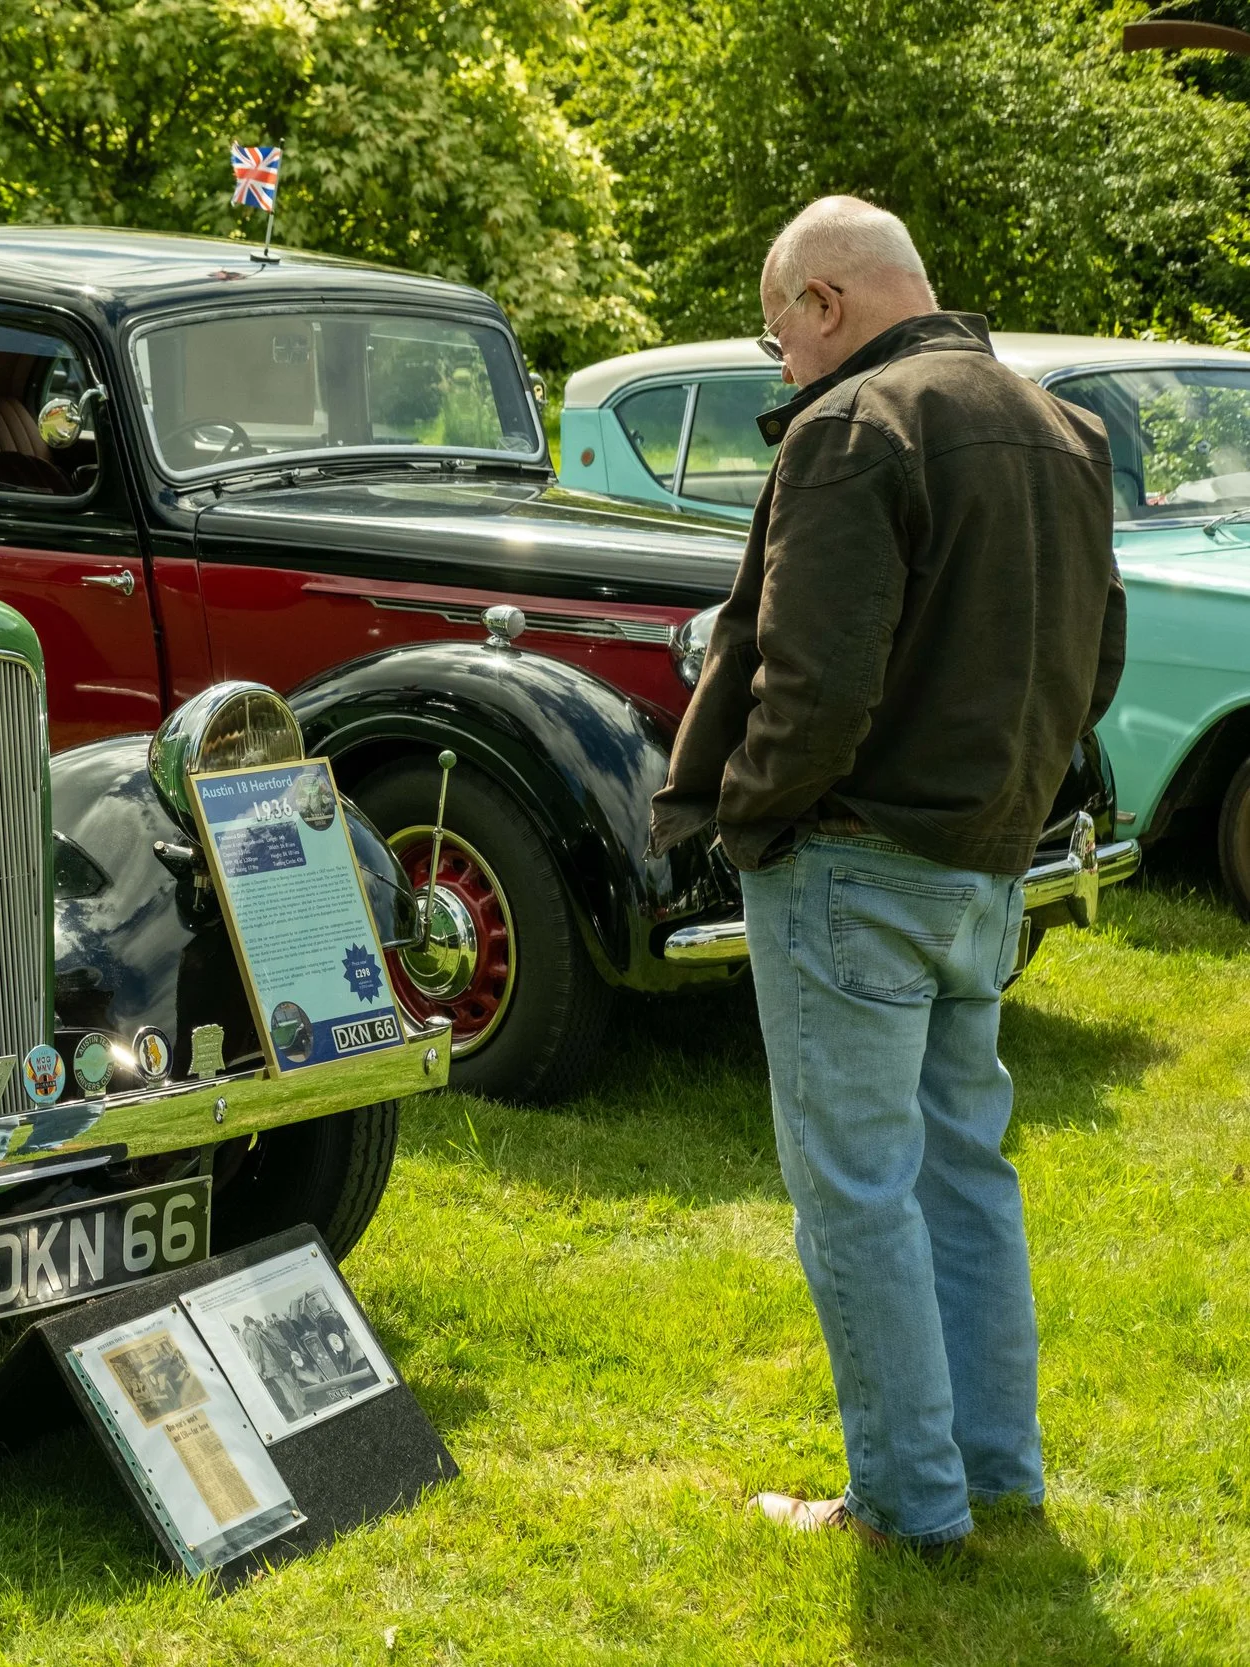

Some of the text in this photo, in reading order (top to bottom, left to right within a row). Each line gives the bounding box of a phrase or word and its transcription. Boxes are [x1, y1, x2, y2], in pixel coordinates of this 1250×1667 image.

[202, 775, 293, 798] Austin 18 Hertford
[253, 797, 293, 821] 1936
[355, 968, 371, 978] £298
[338, 1018, 395, 1048] DKN 66
[78, 1036, 98, 1054] AUSTIN
[77, 1070, 100, 1090] DRIVERS
[122, 1193, 197, 1273] 66
